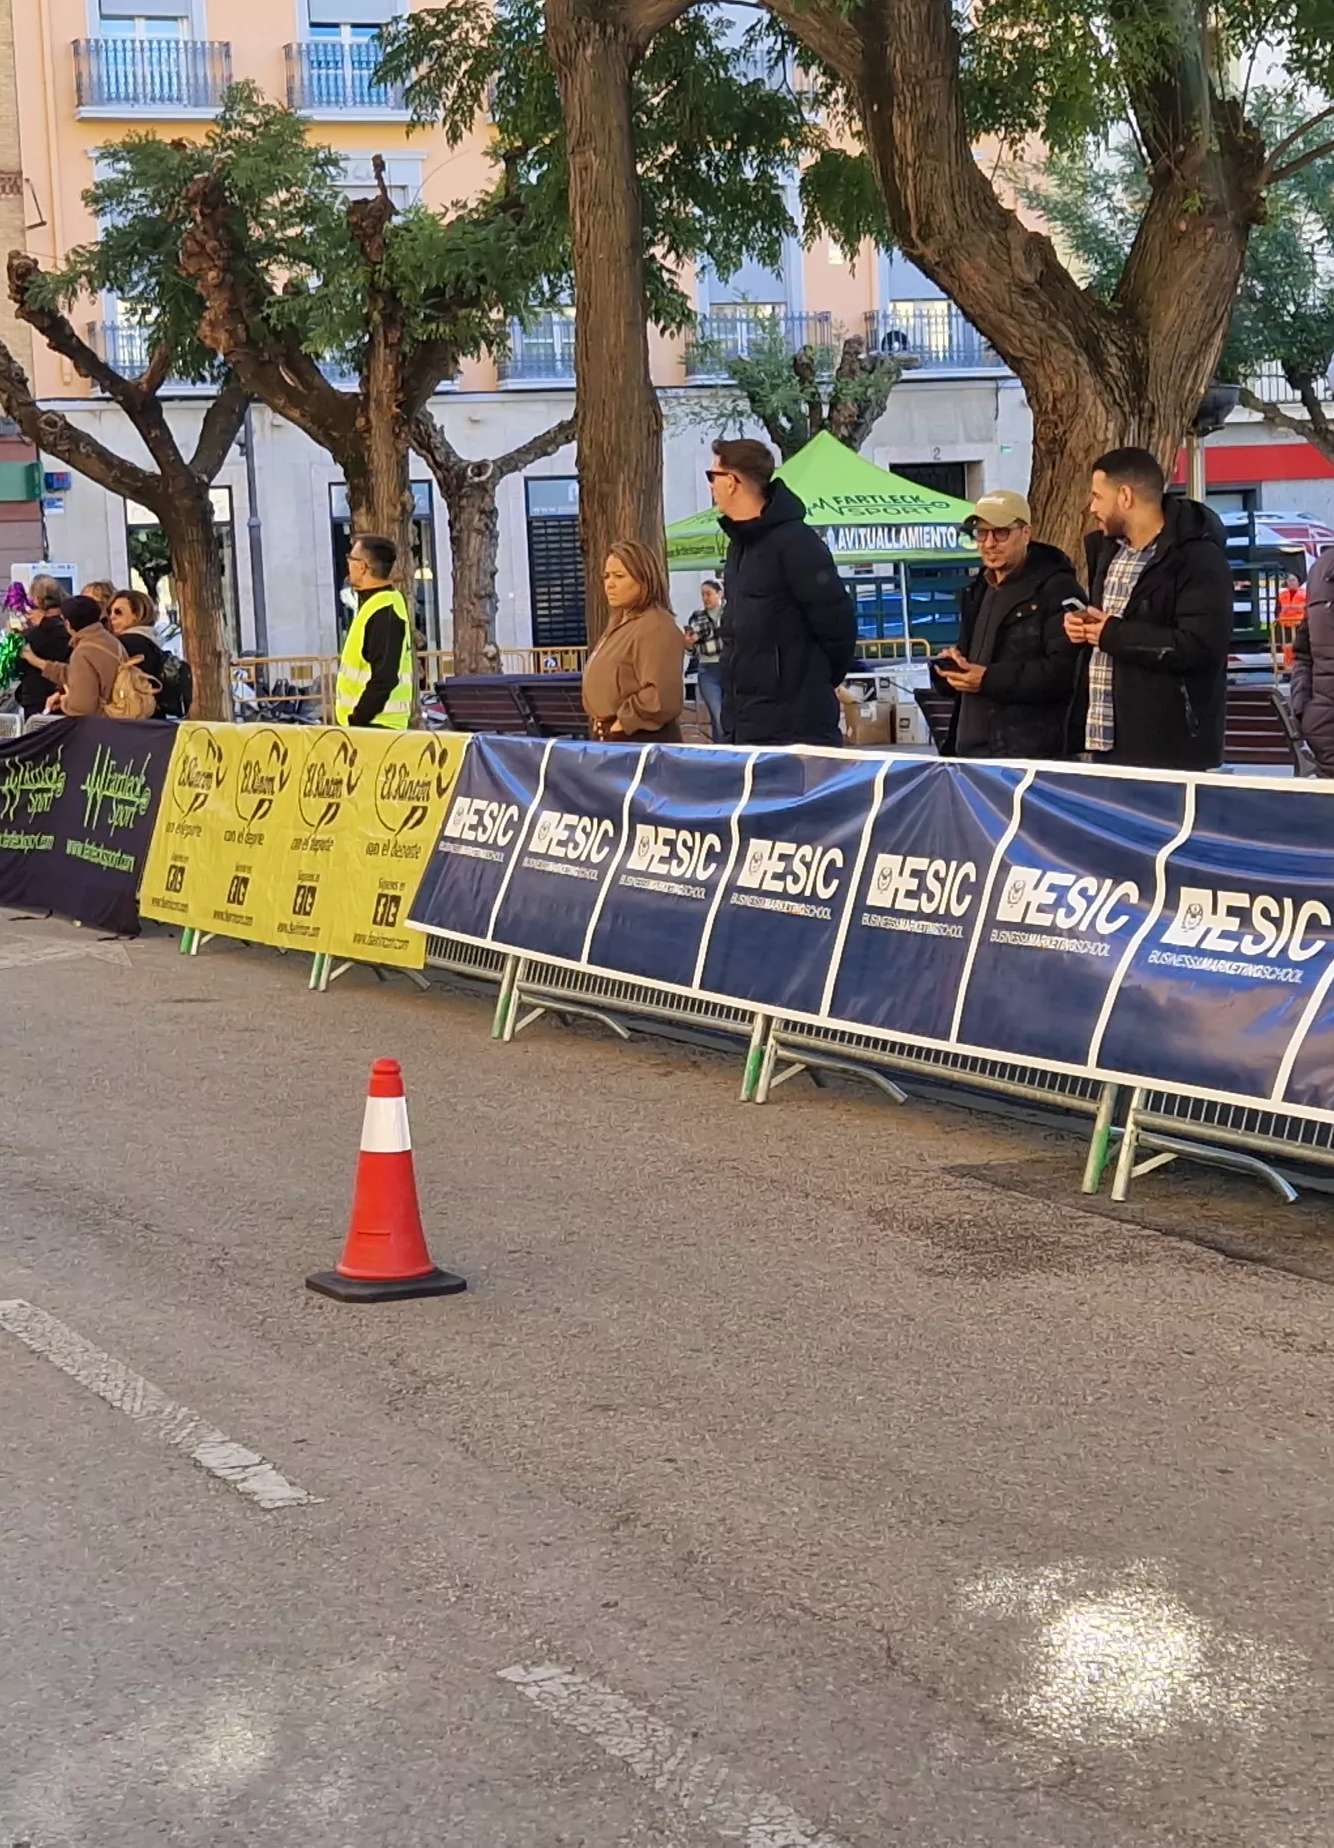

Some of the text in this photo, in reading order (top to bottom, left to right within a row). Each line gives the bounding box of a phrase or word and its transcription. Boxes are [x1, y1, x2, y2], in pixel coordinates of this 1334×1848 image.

[932, 447, 941, 461] 2
[832, 494, 925, 505] FARTLECK
[847, 506, 933, 517] SPORT
[838, 525, 957, 551] AVITUALLAMIENTO
[380, 762, 432, 803] El Rincón
[108, 797, 137, 837] Sport
[461, 799, 520, 847] ESIC
[547, 812, 614, 864] ESIC
[648, 825, 722, 881] ESIC
[762, 841, 844, 900] ESIC
[895, 856, 977, 918] ESIC
[1024, 871, 1139, 935] ESIC
[1200, 890, 1332, 962] ESIC
